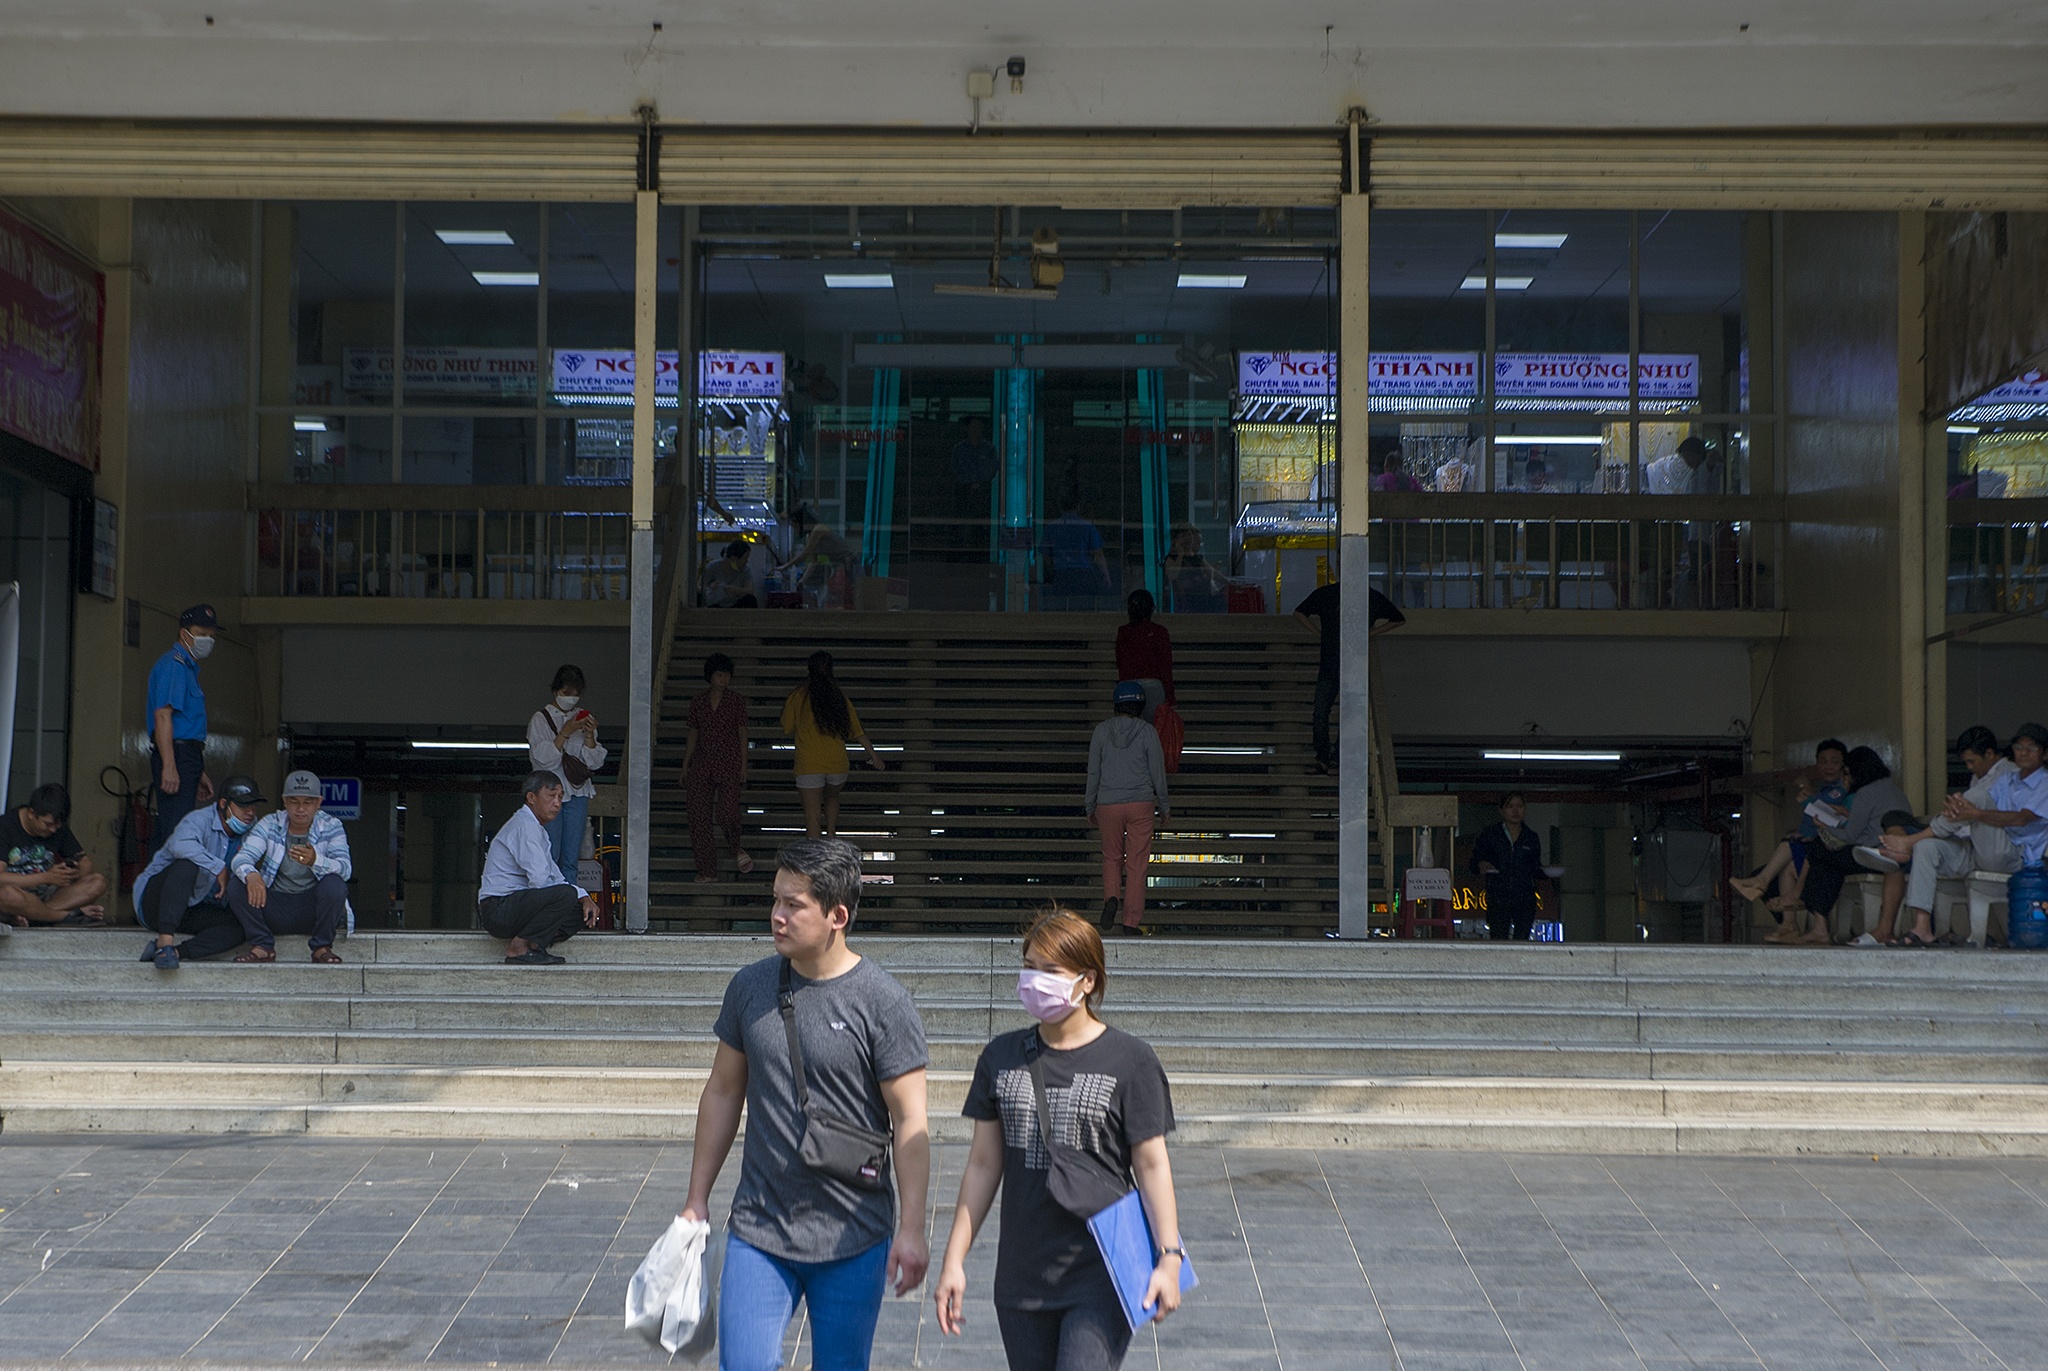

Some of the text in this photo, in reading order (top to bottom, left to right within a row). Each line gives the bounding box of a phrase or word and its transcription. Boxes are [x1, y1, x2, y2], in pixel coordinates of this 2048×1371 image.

[1272, 351, 1290, 362] KIM
[444, 356, 482, 373] NHƯ
[711, 361, 775, 375] MAI
[1373, 362, 1474, 376] THANH
[1524, 361, 1692, 380] PHƯỢNG NHƯ
[605, 378, 635, 386] DOAN
[1245, 379, 1278, 388] CHUYÊN
[1303, 379, 1321, 388] BÁN
[1495, 379, 1524, 388] HUYÊN
[320, 783, 349, 802] TM
